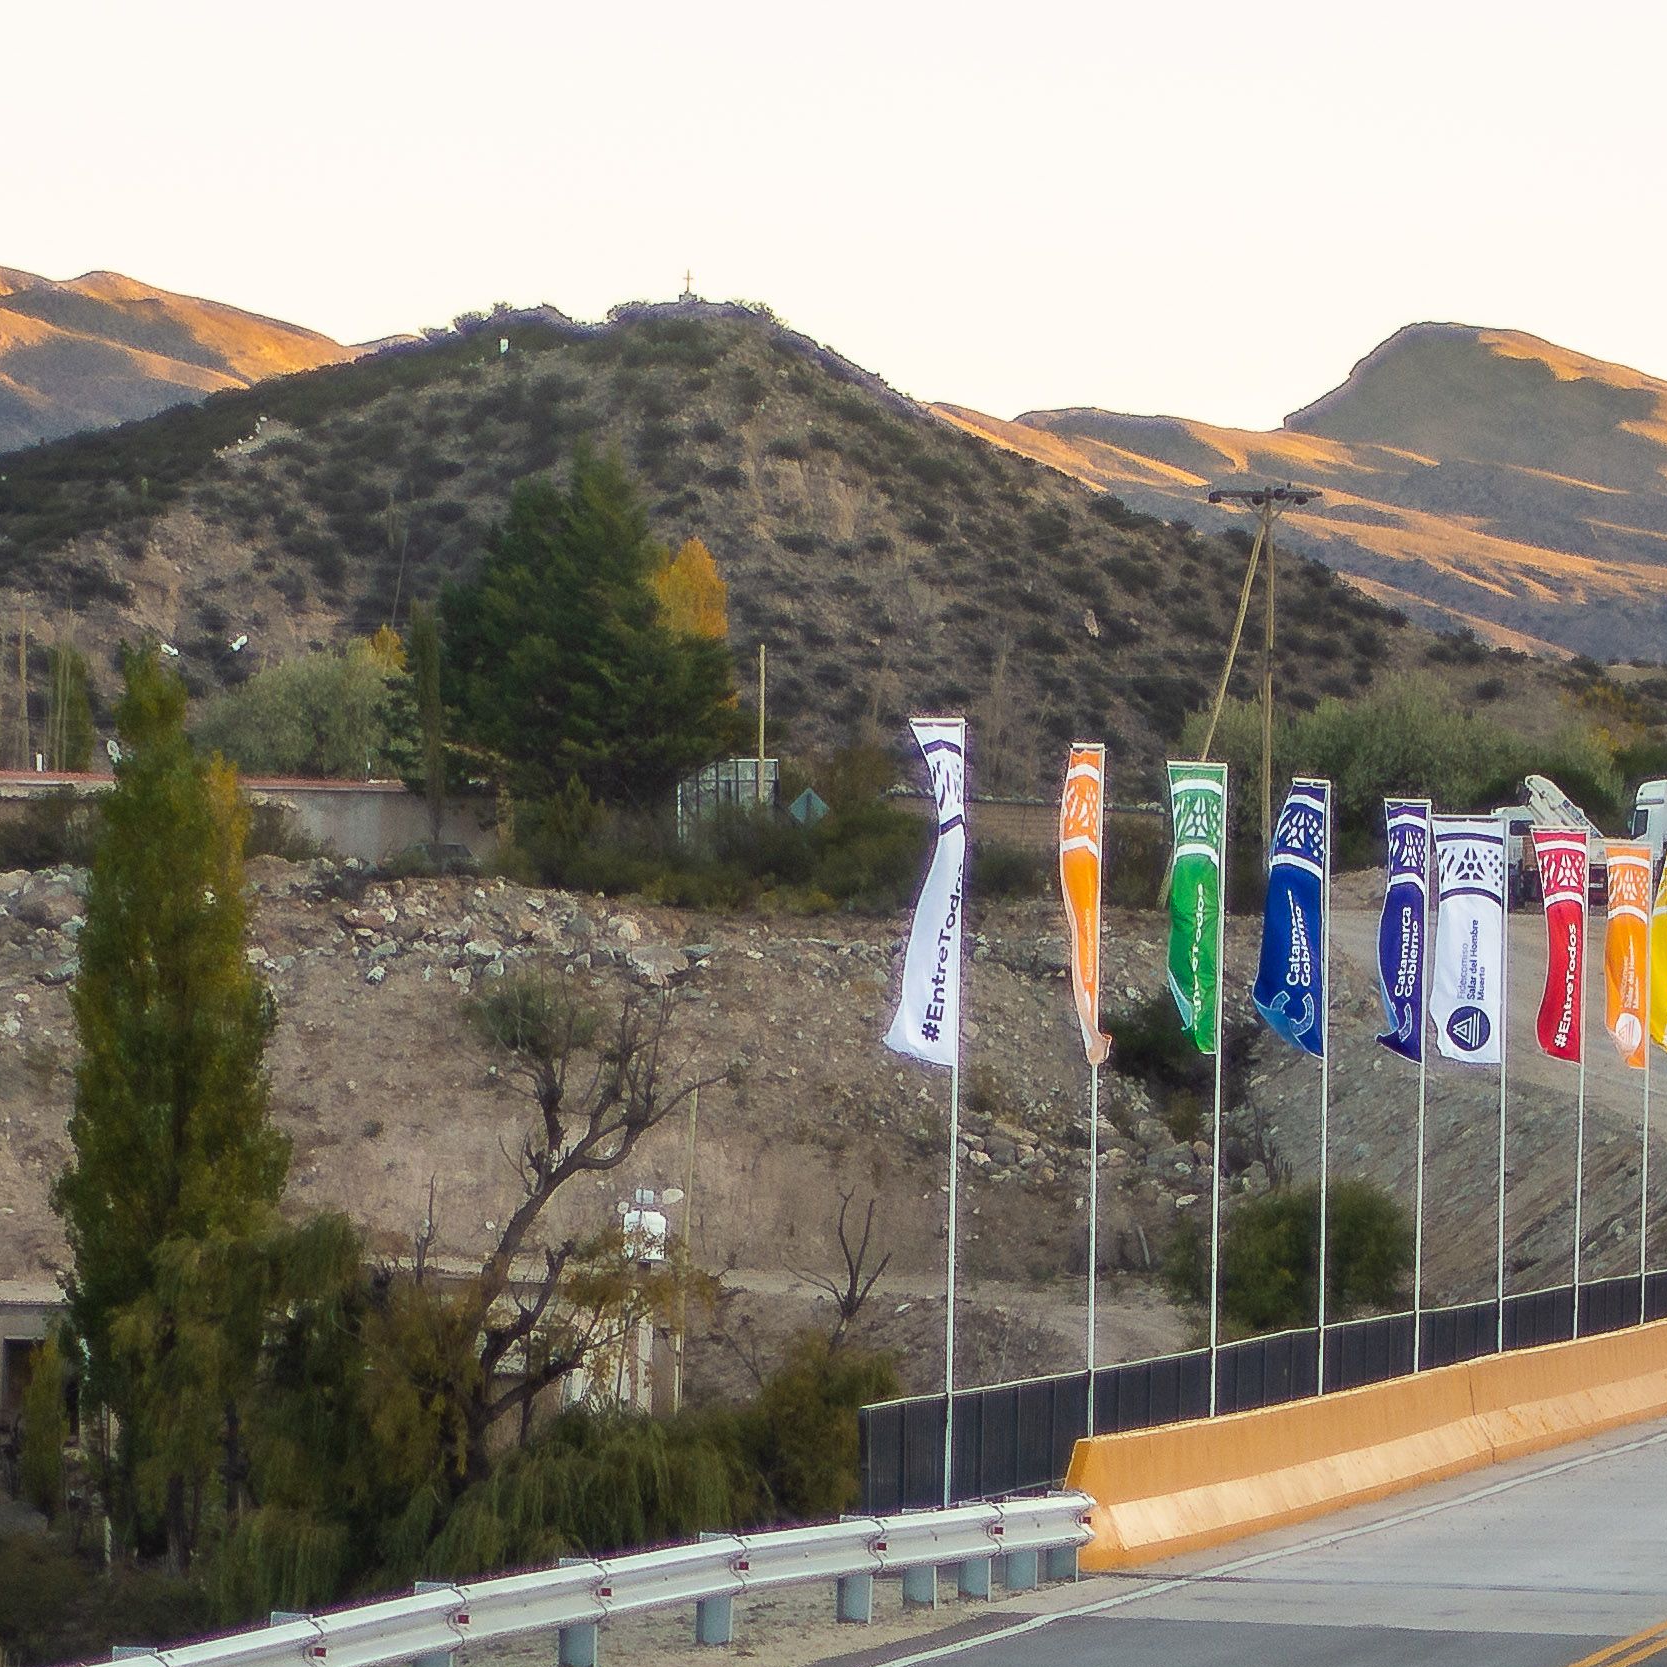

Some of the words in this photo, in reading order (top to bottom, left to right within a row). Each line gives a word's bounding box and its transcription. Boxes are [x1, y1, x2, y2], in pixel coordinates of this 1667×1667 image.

[1286, 888, 1301, 986] Catam
[1394, 906, 1412, 997] Catamarca
[1404, 920, 1419, 998] Gobierno
[1470, 919, 1479, 958] Hombre
[1457, 943, 1469, 1000] Fideicomiso
[1467, 978, 1477, 1000] Salar
[1469, 958, 1477, 974] del
[1477, 966, 1486, 1001] Muerto
[1554, 922, 1577, 1049] #EntreTodos
